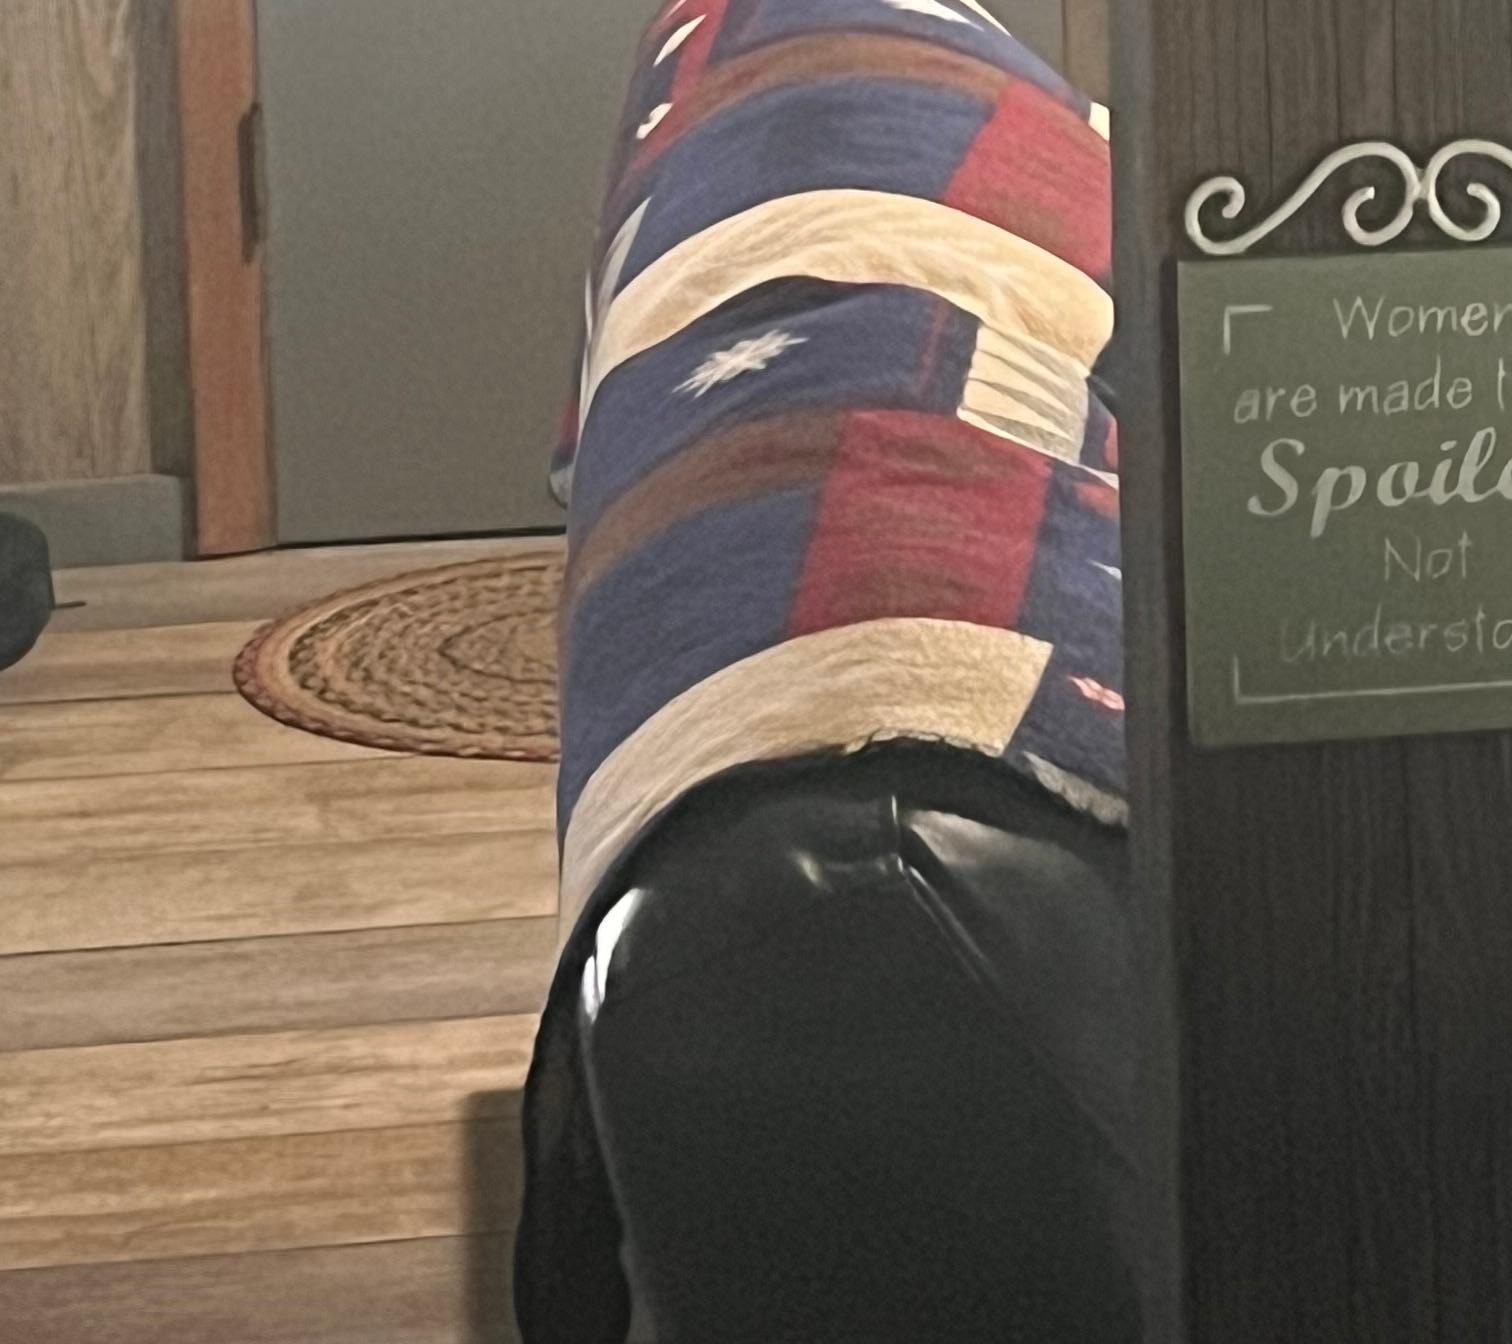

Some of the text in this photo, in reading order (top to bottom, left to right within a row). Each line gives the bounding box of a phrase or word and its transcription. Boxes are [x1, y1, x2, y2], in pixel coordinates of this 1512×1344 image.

[1233, 383, 1318, 424] are
[1338, 354, 1474, 416] made
[1383, 530, 1475, 583] Not
